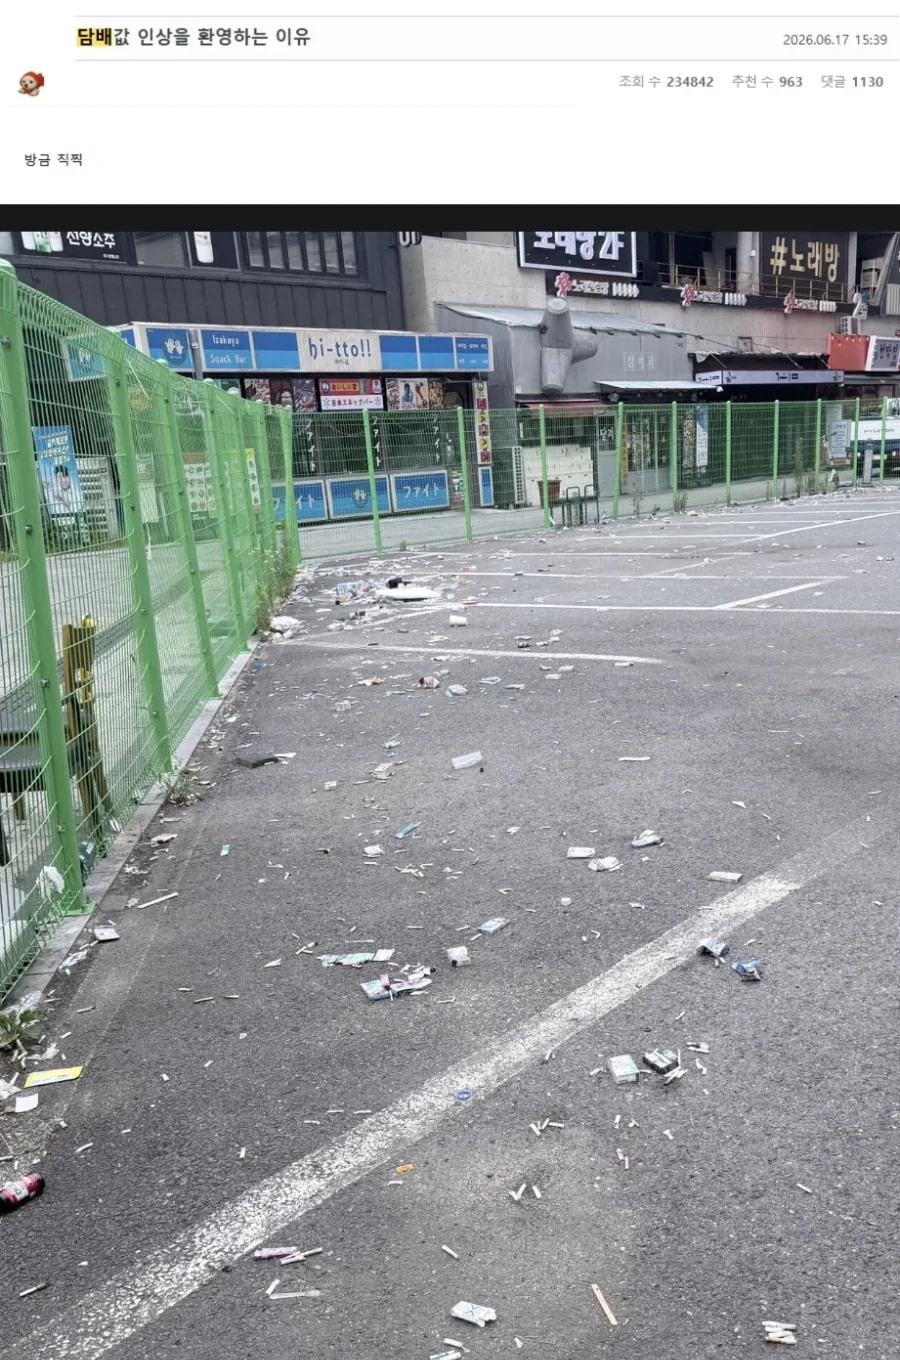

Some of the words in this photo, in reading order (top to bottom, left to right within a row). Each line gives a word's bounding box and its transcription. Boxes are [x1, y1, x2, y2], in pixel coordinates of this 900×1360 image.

[769, 236, 841, 283] #노래방
[212, 334, 240, 348] Izakaya
[308, 337, 372, 360] hi-tto!!
[210, 354, 232, 364] Snack
[235, 355, 246, 364] Bar
